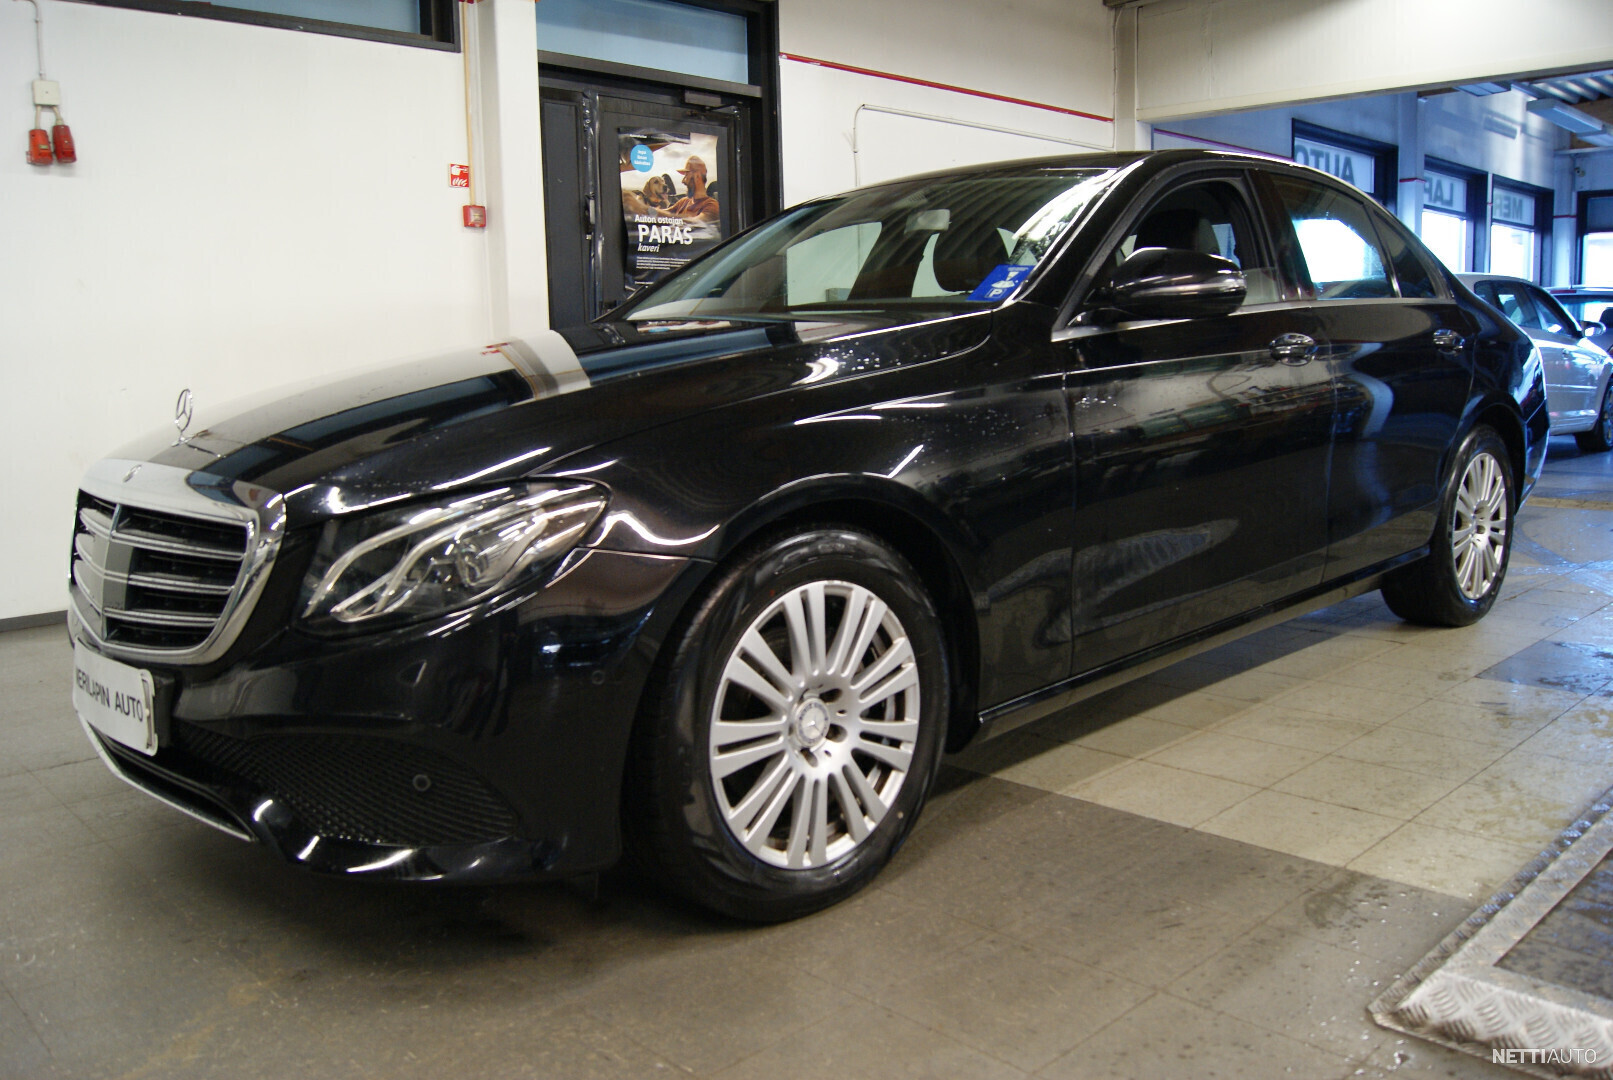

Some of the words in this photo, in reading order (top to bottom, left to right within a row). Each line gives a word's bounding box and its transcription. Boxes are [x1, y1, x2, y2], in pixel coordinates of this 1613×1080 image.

[635, 215, 656, 223] Auton
[658, 217, 683, 226] ostajan
[638, 225, 693, 245] PARAS
[638, 243, 660, 252] kaveri
[989, 289, 1003, 298] P
[115, 691, 143, 722] AUTO
